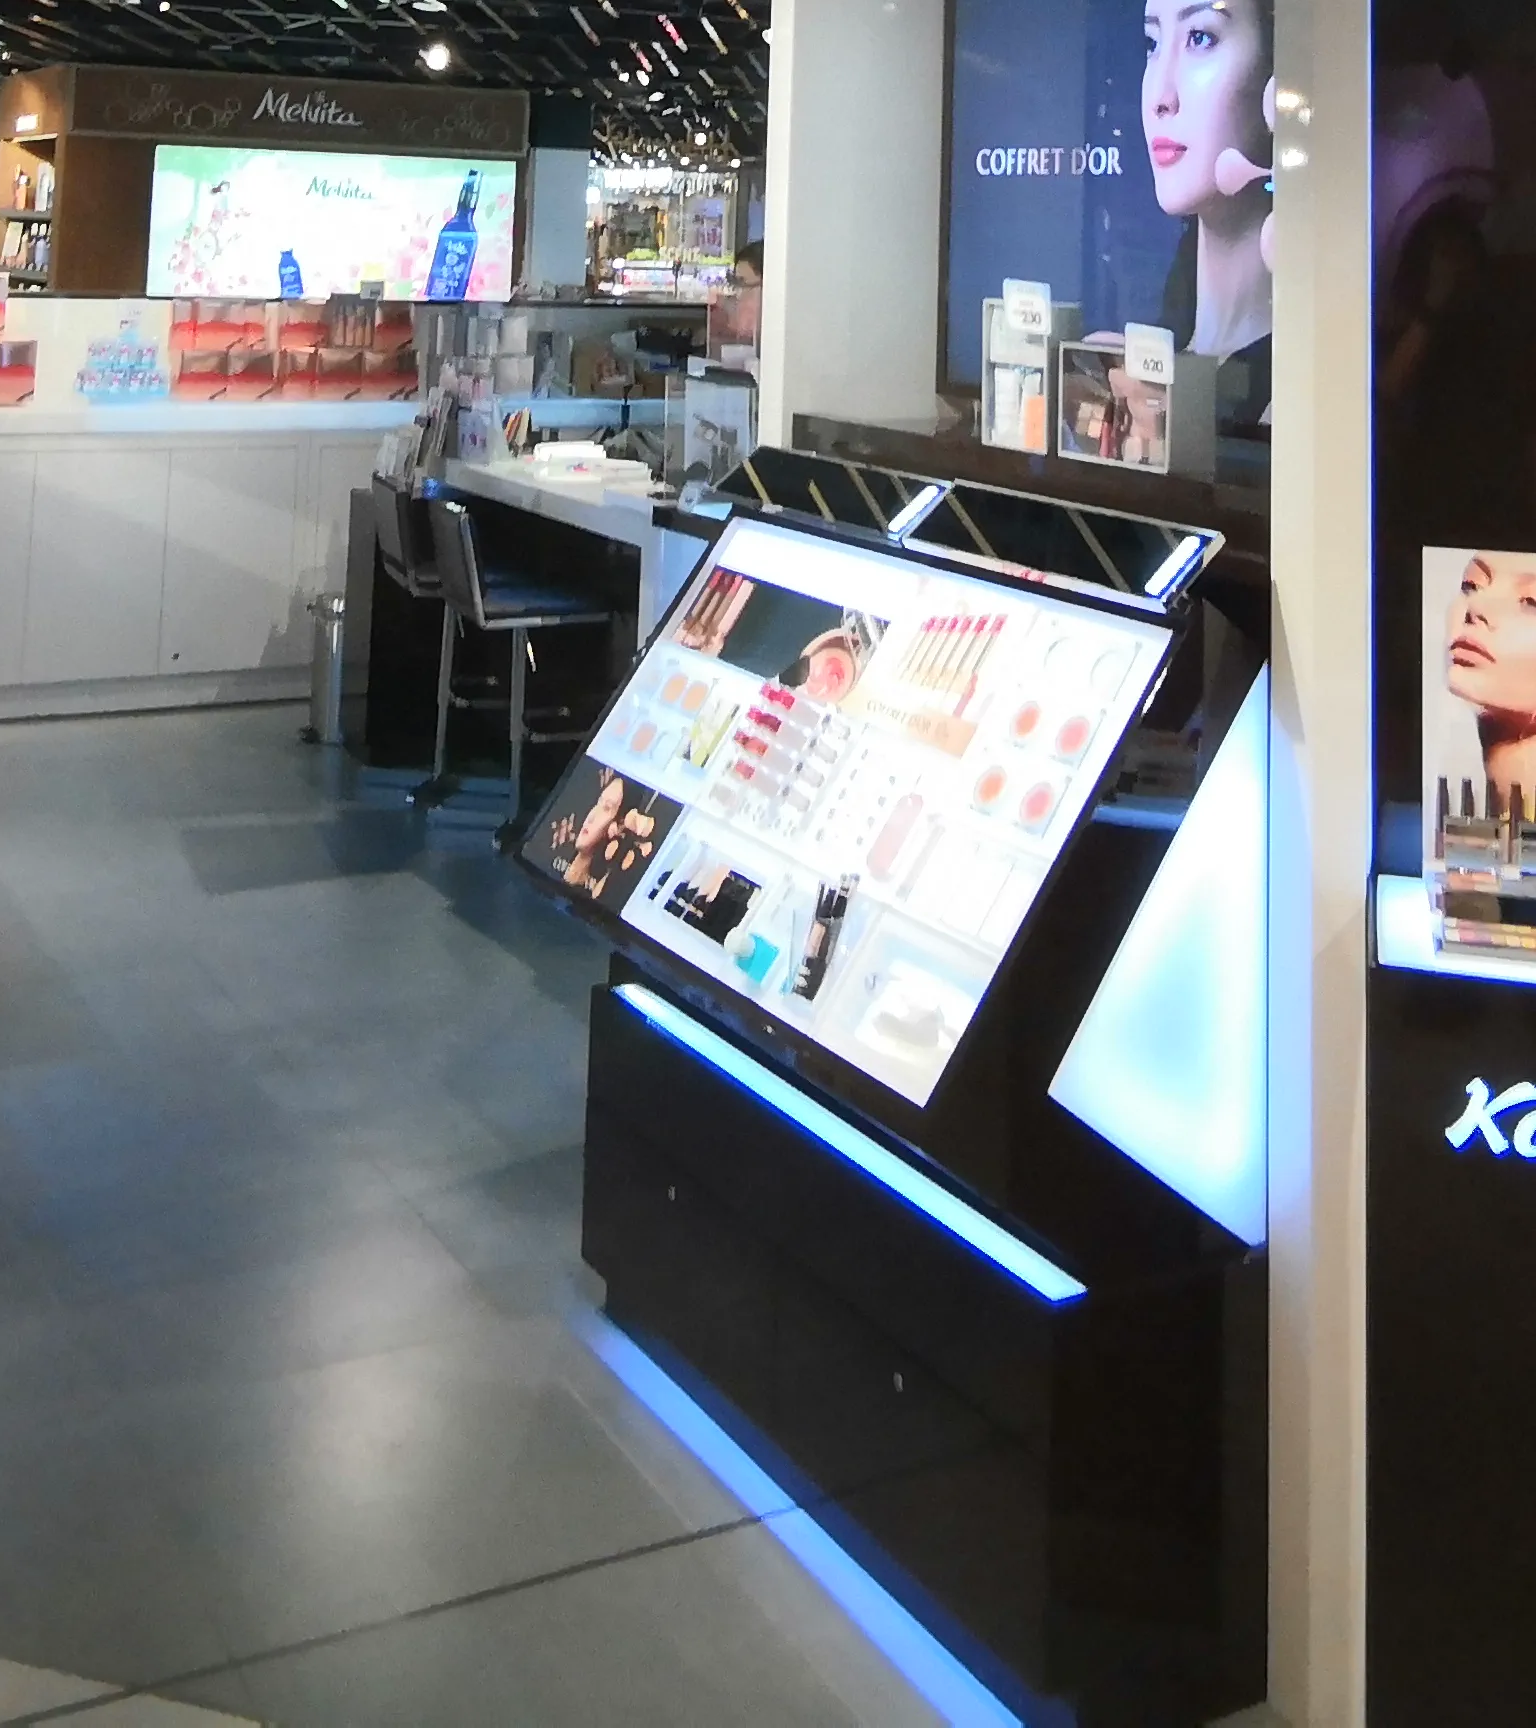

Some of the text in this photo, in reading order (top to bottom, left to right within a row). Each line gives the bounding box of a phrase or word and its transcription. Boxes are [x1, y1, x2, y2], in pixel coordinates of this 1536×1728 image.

[252, 87, 364, 127] Melvita
[976, 142, 1124, 176] COFFRET D'OR
